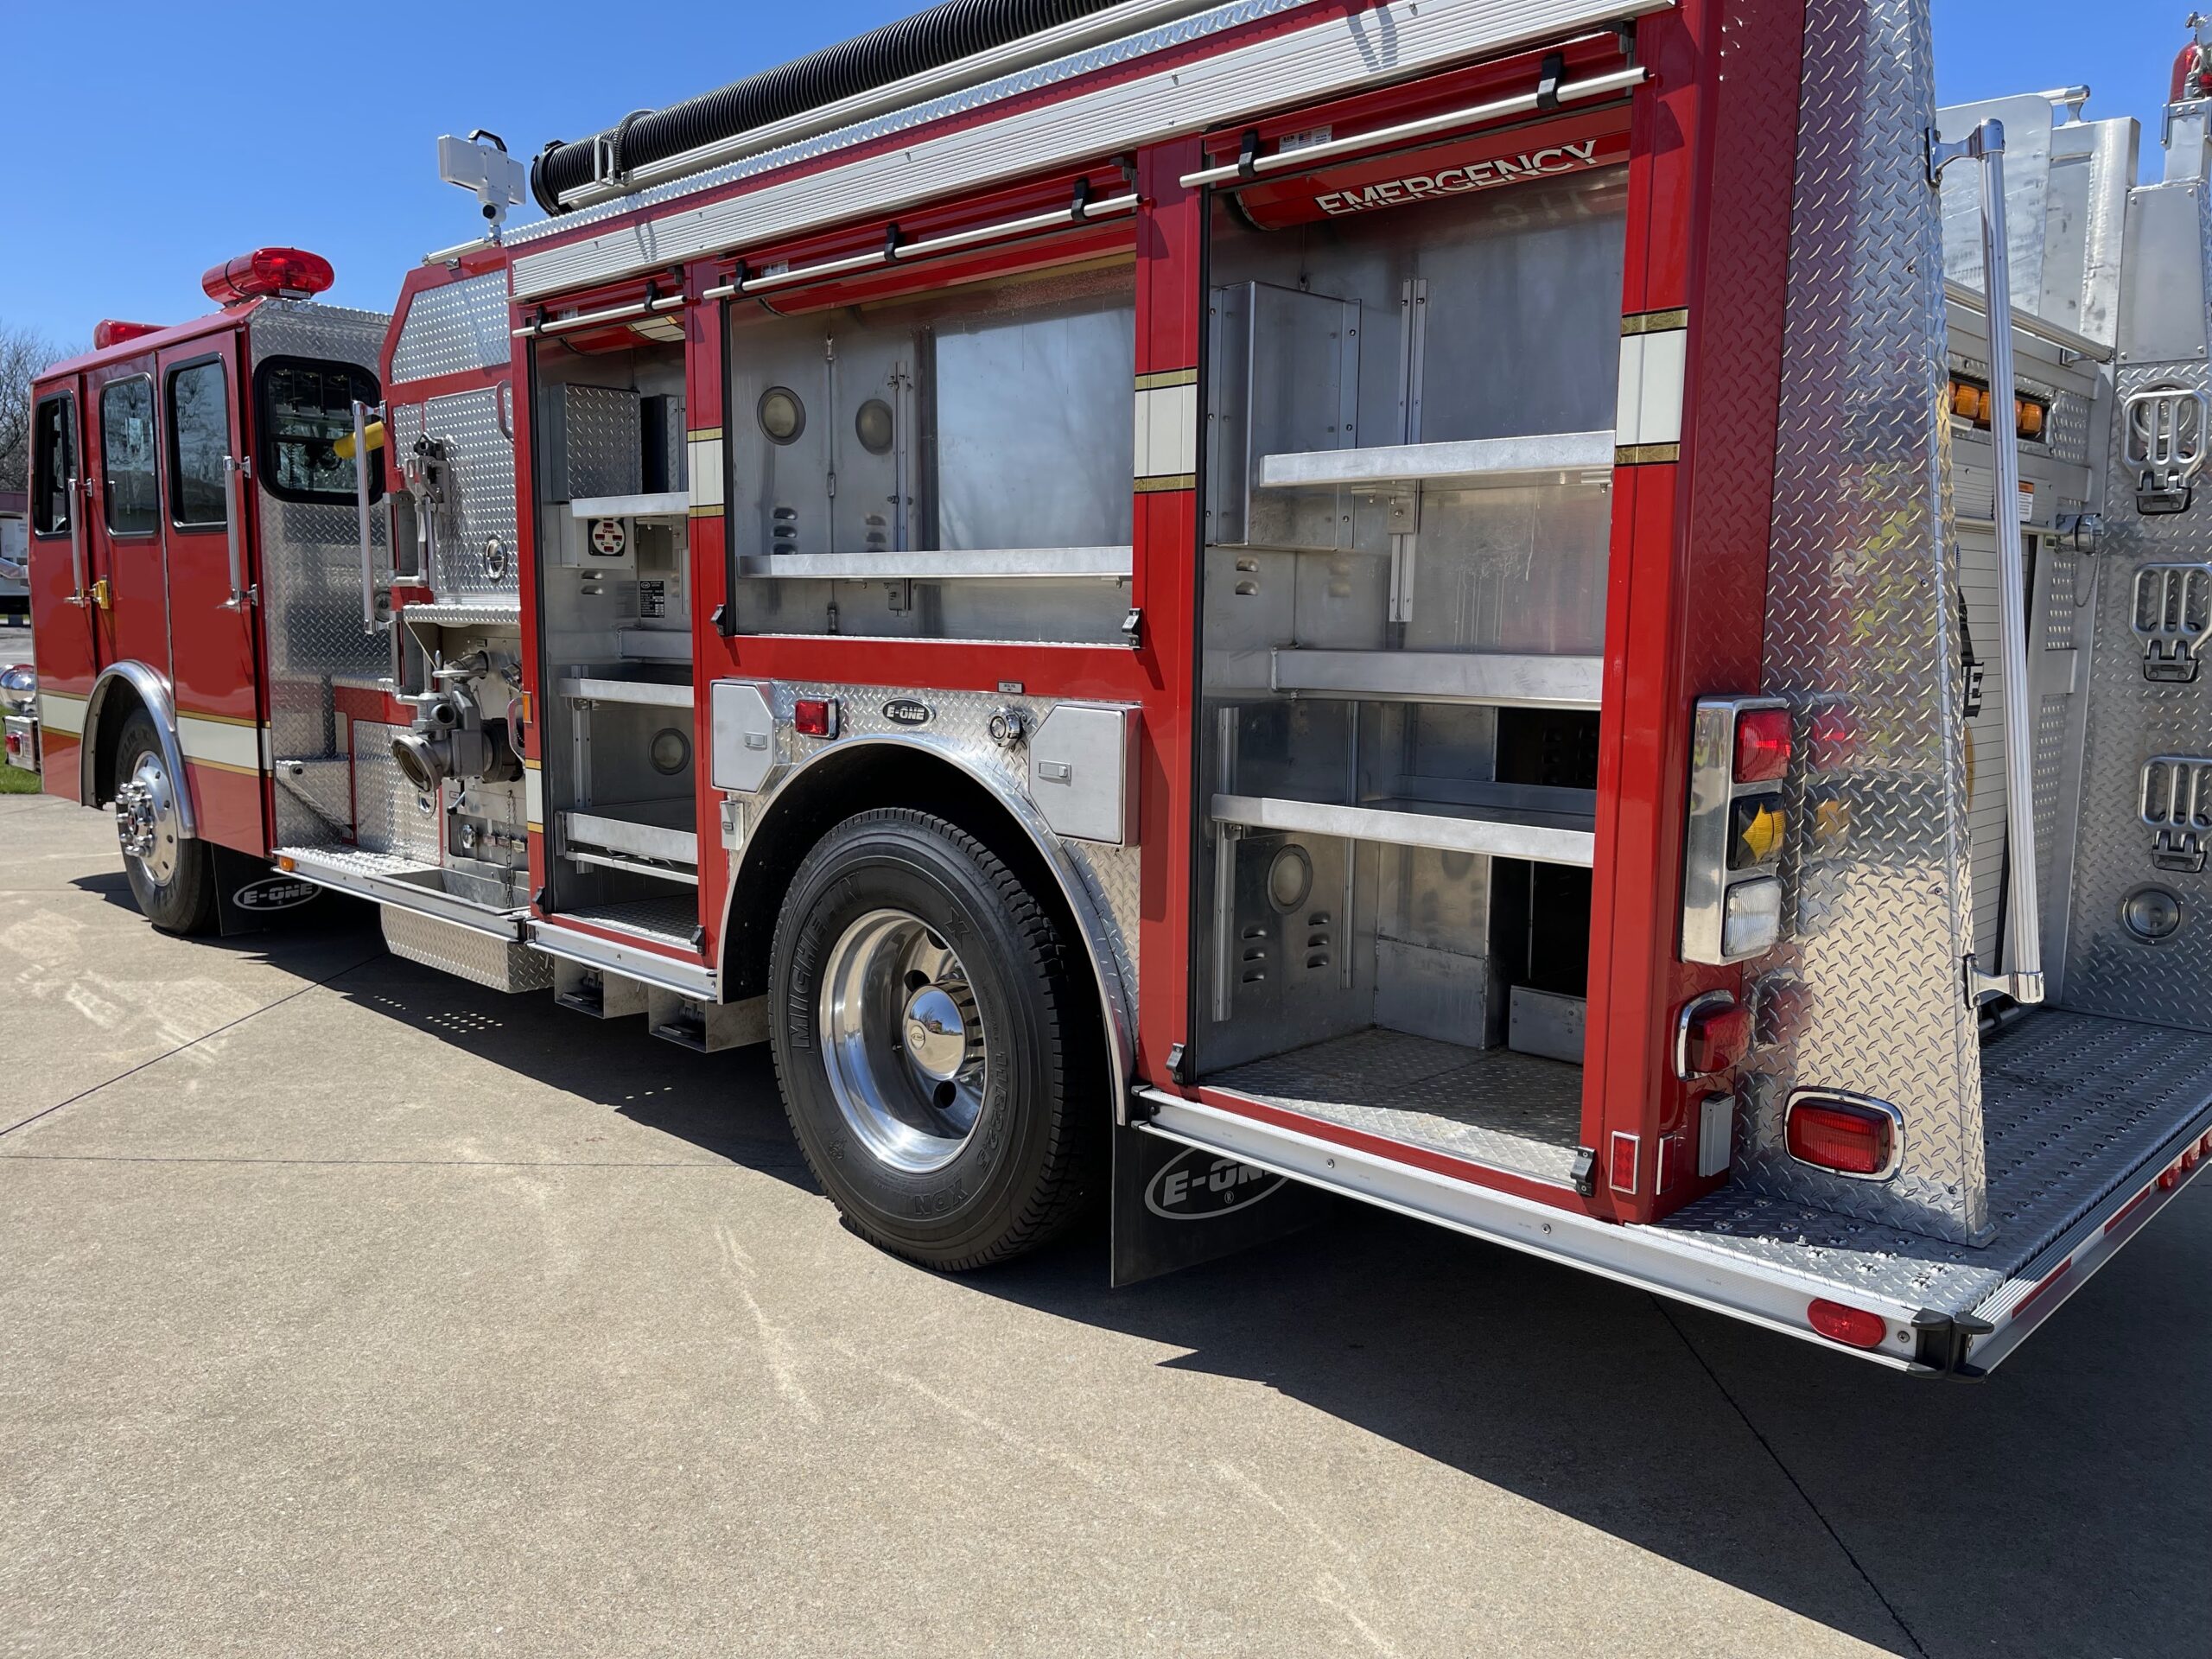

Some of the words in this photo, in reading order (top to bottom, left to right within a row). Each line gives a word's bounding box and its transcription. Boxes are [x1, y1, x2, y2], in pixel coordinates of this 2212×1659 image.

[1315, 139, 1597, 215] EMERGENCY
[887, 705, 925, 721] E-ONE
[244, 883, 312, 904] E-ONE
[790, 871, 864, 1049] MICHELIN
[1163, 1159, 1273, 1206] E-ON
